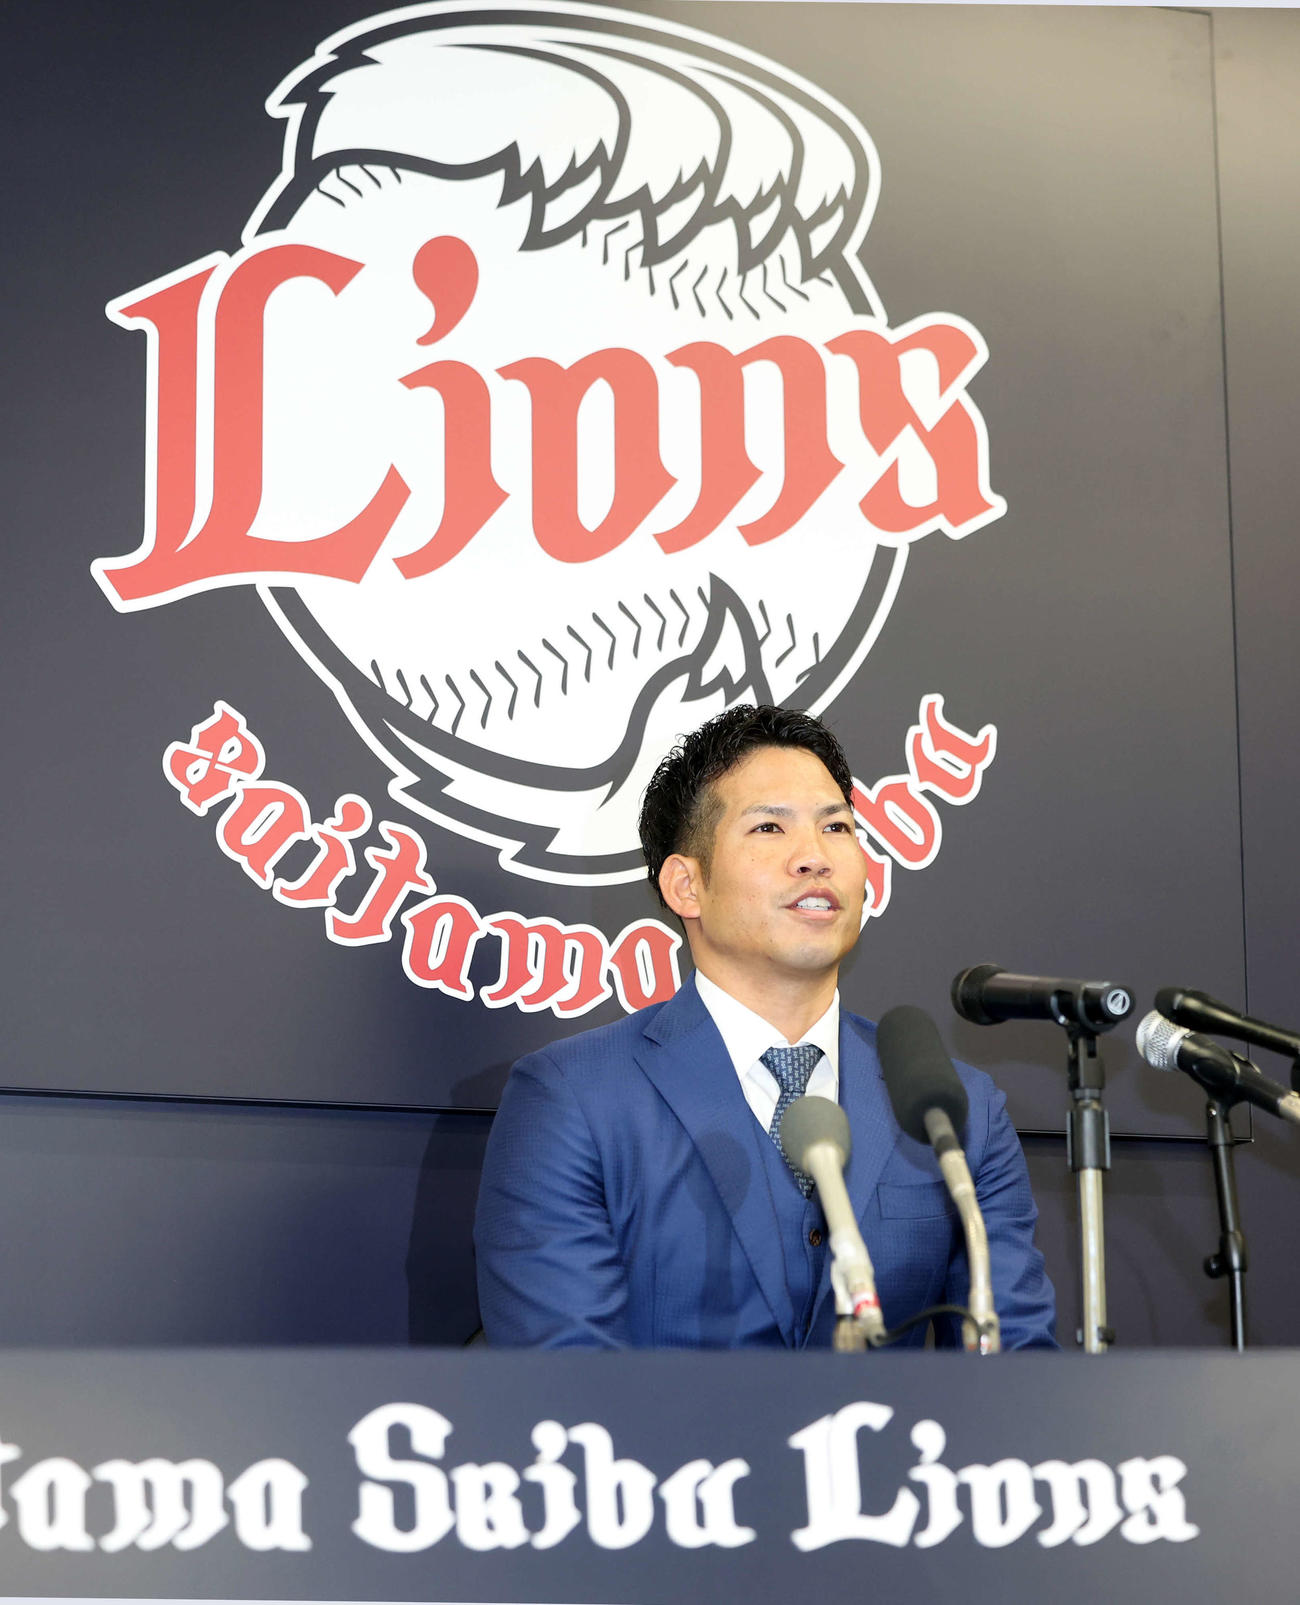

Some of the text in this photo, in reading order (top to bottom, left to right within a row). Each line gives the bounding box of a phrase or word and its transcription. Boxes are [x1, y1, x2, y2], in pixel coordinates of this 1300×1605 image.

[99, 234, 1000, 605] Lions
[347, 1402, 756, 1553] Seibu
[788, 1401, 1200, 1552] Lions
